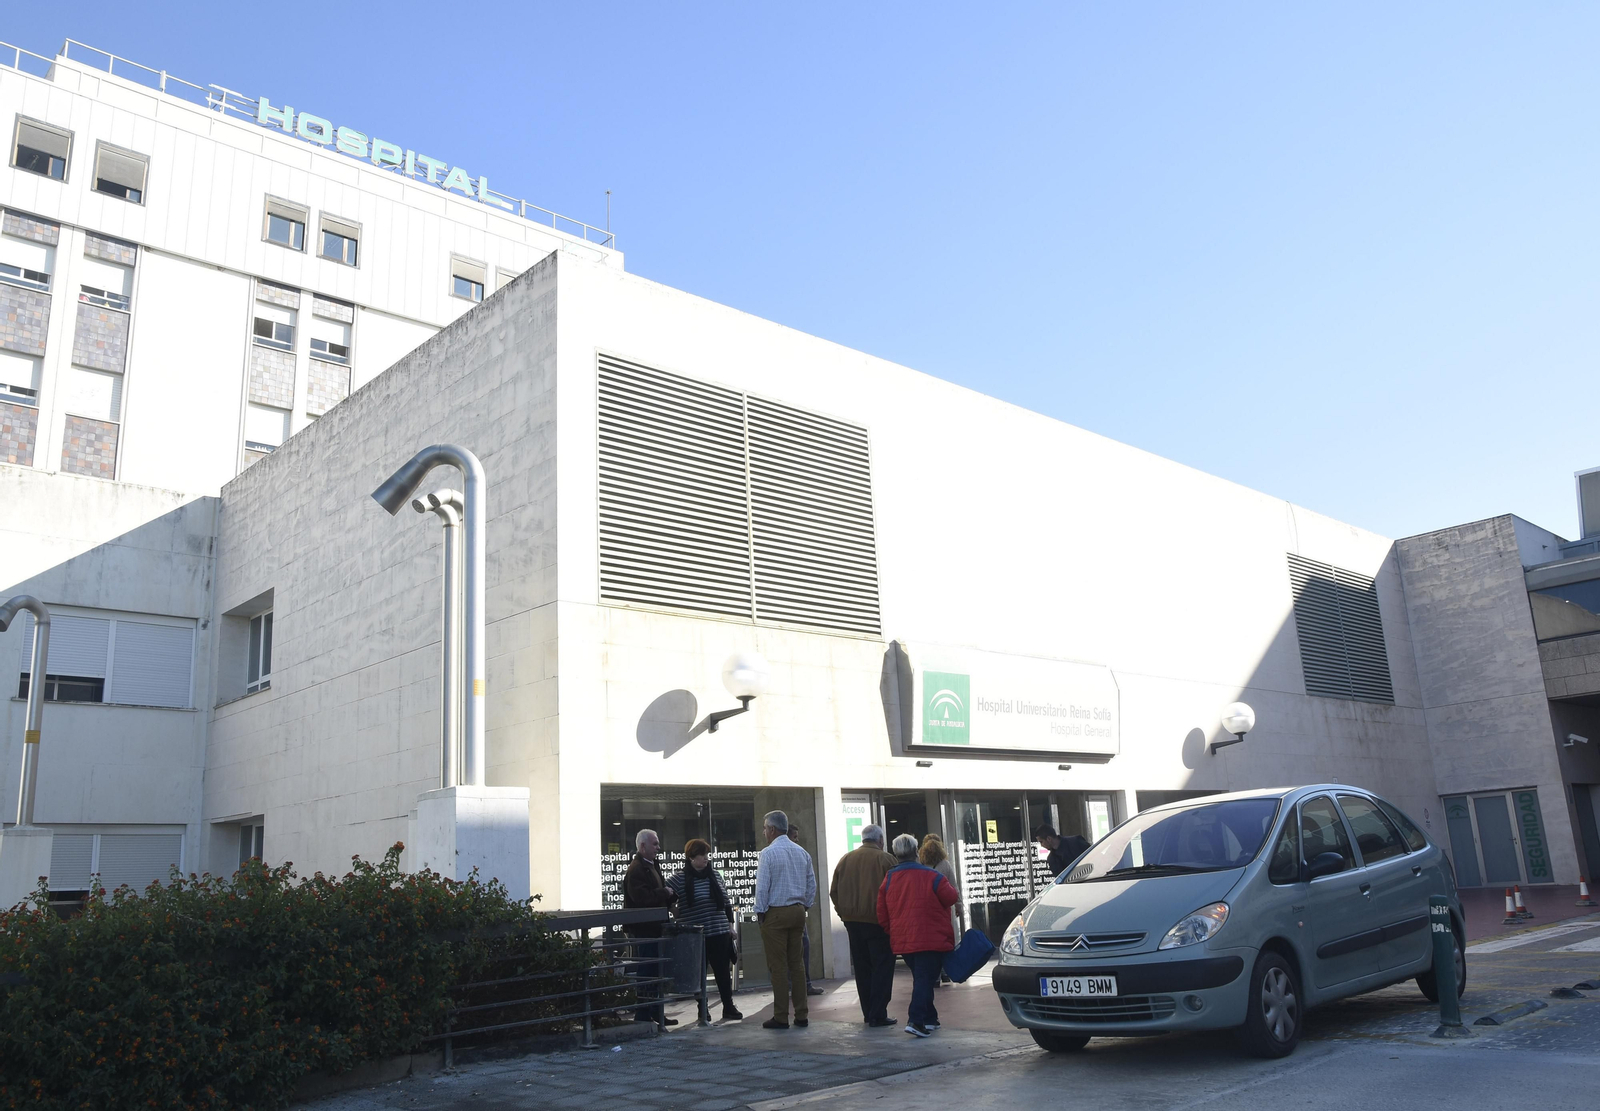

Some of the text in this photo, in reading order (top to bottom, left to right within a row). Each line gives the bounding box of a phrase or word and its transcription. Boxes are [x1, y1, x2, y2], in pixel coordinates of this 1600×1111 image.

[258, 96, 513, 210] HOSPITAL
[978, 697, 1111, 721] Hospital Universitario Reina Sofía
[1050, 722, 1111, 738] Hospital General
[842, 804, 865, 814] Acceso
[1518, 792, 1547, 878] SEGURIDAD
[986, 841, 1005, 849] hospital
[1006, 840, 1023, 849] general
[707, 850, 738, 860] general
[994, 849, 1011, 857] general
[1004, 878, 1022, 886] hospital
[1051, 979, 1112, 994] 9149 BMM
